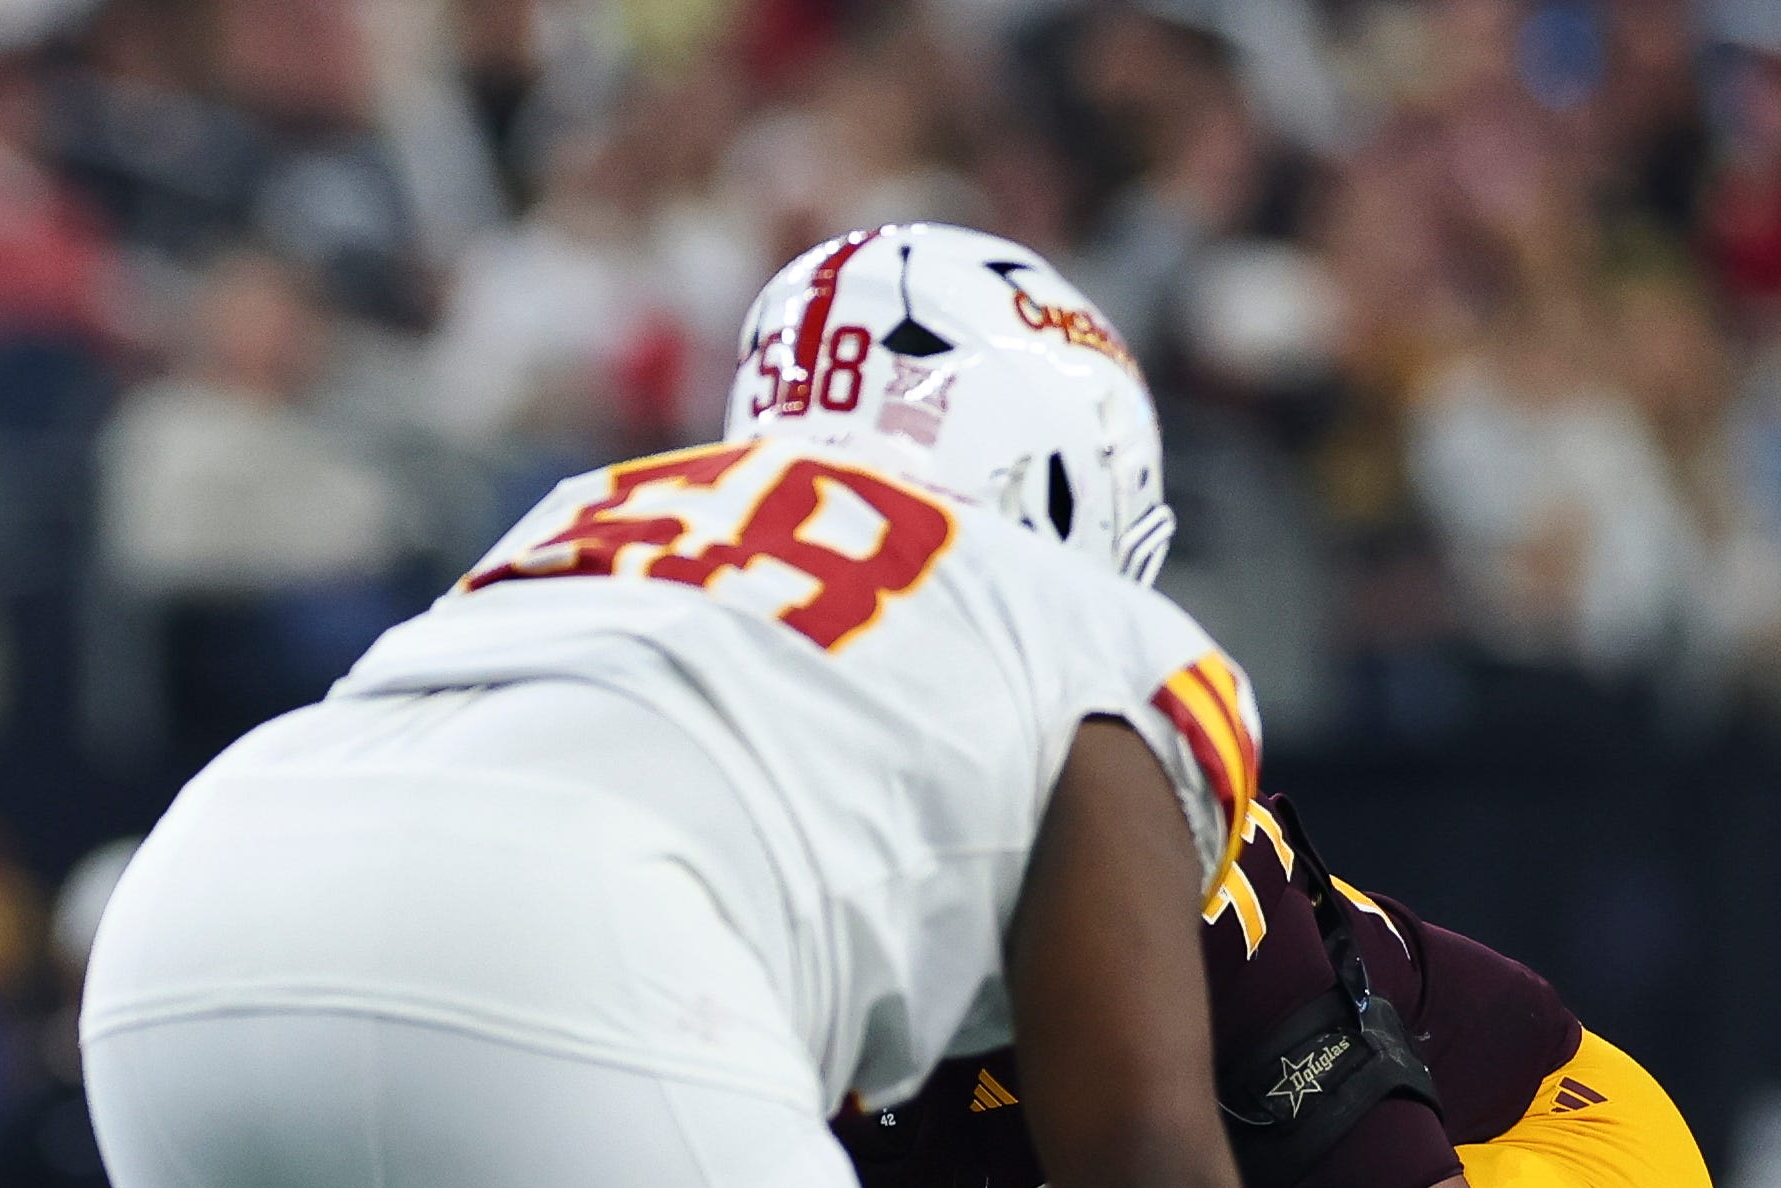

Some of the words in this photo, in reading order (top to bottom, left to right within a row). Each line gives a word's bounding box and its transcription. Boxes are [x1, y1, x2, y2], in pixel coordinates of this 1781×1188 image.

[459, 438, 958, 656] 58
[1289, 1038, 1351, 1091] Douglas
[880, 1113, 897, 1127] 42
